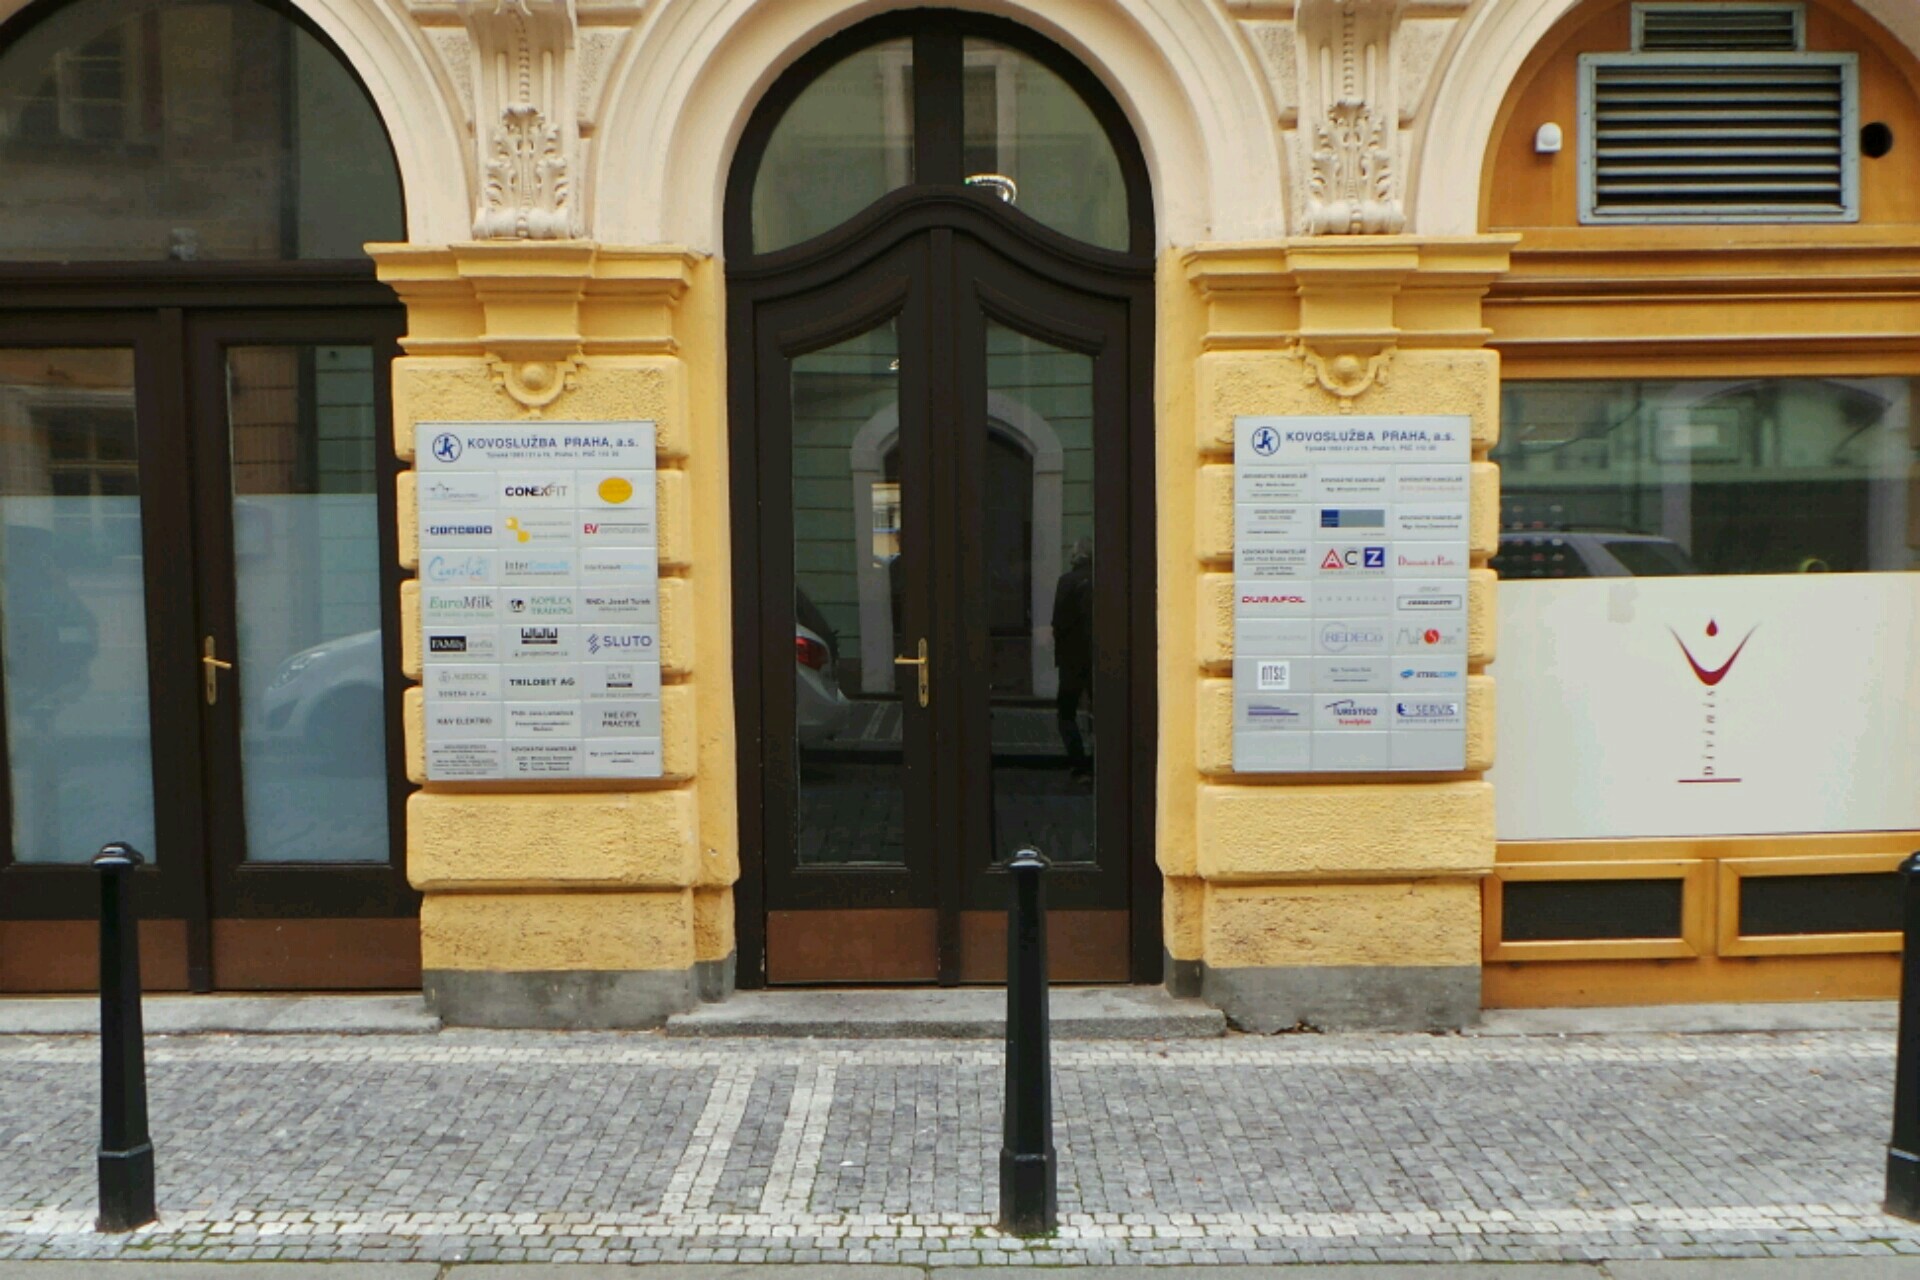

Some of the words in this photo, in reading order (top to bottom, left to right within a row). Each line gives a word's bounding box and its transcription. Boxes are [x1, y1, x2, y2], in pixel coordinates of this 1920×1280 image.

[467, 434, 557, 449] KOVOSLUŽBA
[564, 436, 613, 449] PRAHA,
[616, 437, 639, 448] a.s.
[1286, 428, 1375, 442] KOVOSLUŽBA
[1382, 430, 1431, 443] PRAHA,
[1433, 432, 1455, 442] a.s.
[584, 523, 599, 534] EV
[429, 594, 493, 609] EuroMilk
[1241, 595, 1306, 604] DURAFOL
[602, 635, 652, 648] SLUTO
[509, 678, 557, 687] TRILOBIT
[602, 719, 641, 728] PRACTICE
